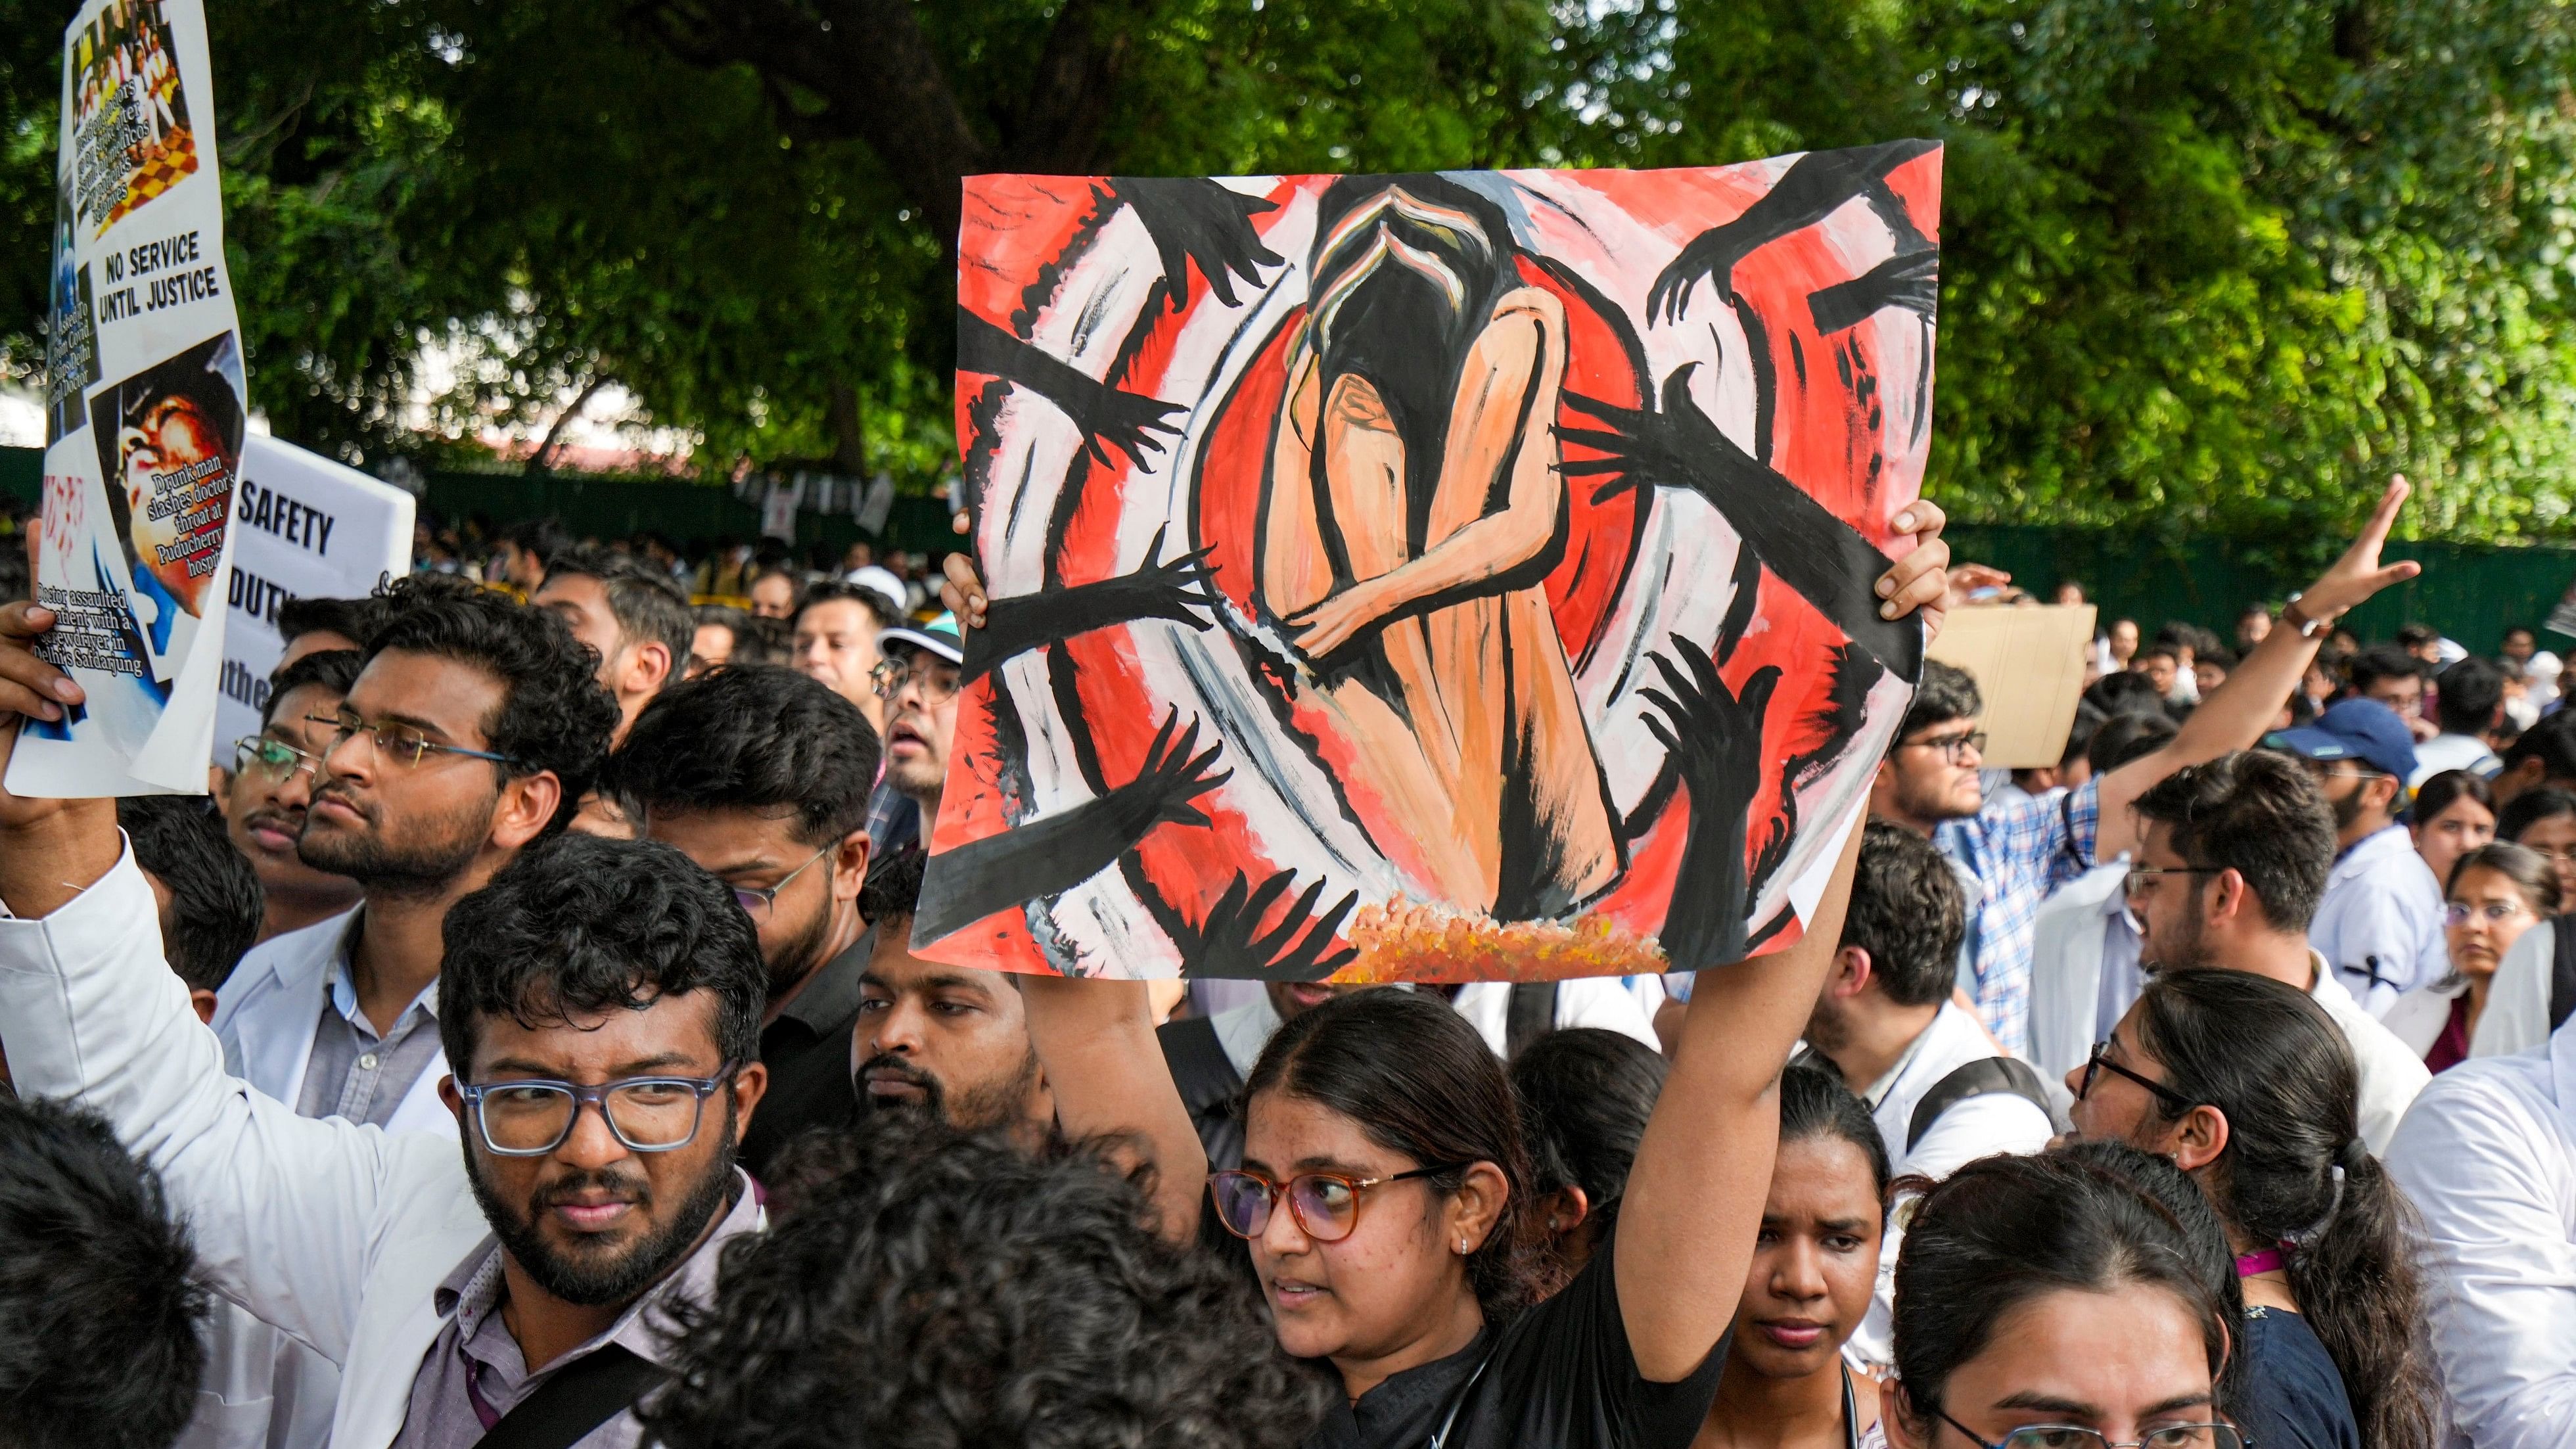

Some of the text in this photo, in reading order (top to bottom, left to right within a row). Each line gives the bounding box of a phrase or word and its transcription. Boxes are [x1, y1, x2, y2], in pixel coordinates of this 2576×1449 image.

[106, 231, 200, 285] NO SERVICE
[100, 265, 220, 324] UNTIL JUSTICE
[70, 340, 91, 369] Delhi
[62, 369, 89, 396] Doctor
[152, 455, 222, 495] Drunk man
[148, 470, 235, 521] slashes doctor's
[175, 501, 223, 534] throat at
[239, 480, 334, 557] SAFETY
[156, 527, 222, 564] Puducherry
[37, 582, 127, 609] Doctor assaulted
[53, 608, 132, 630] atient with a
[111, 630, 126, 651] in
[34, 645, 143, 678] Delhi's Safdarjung
